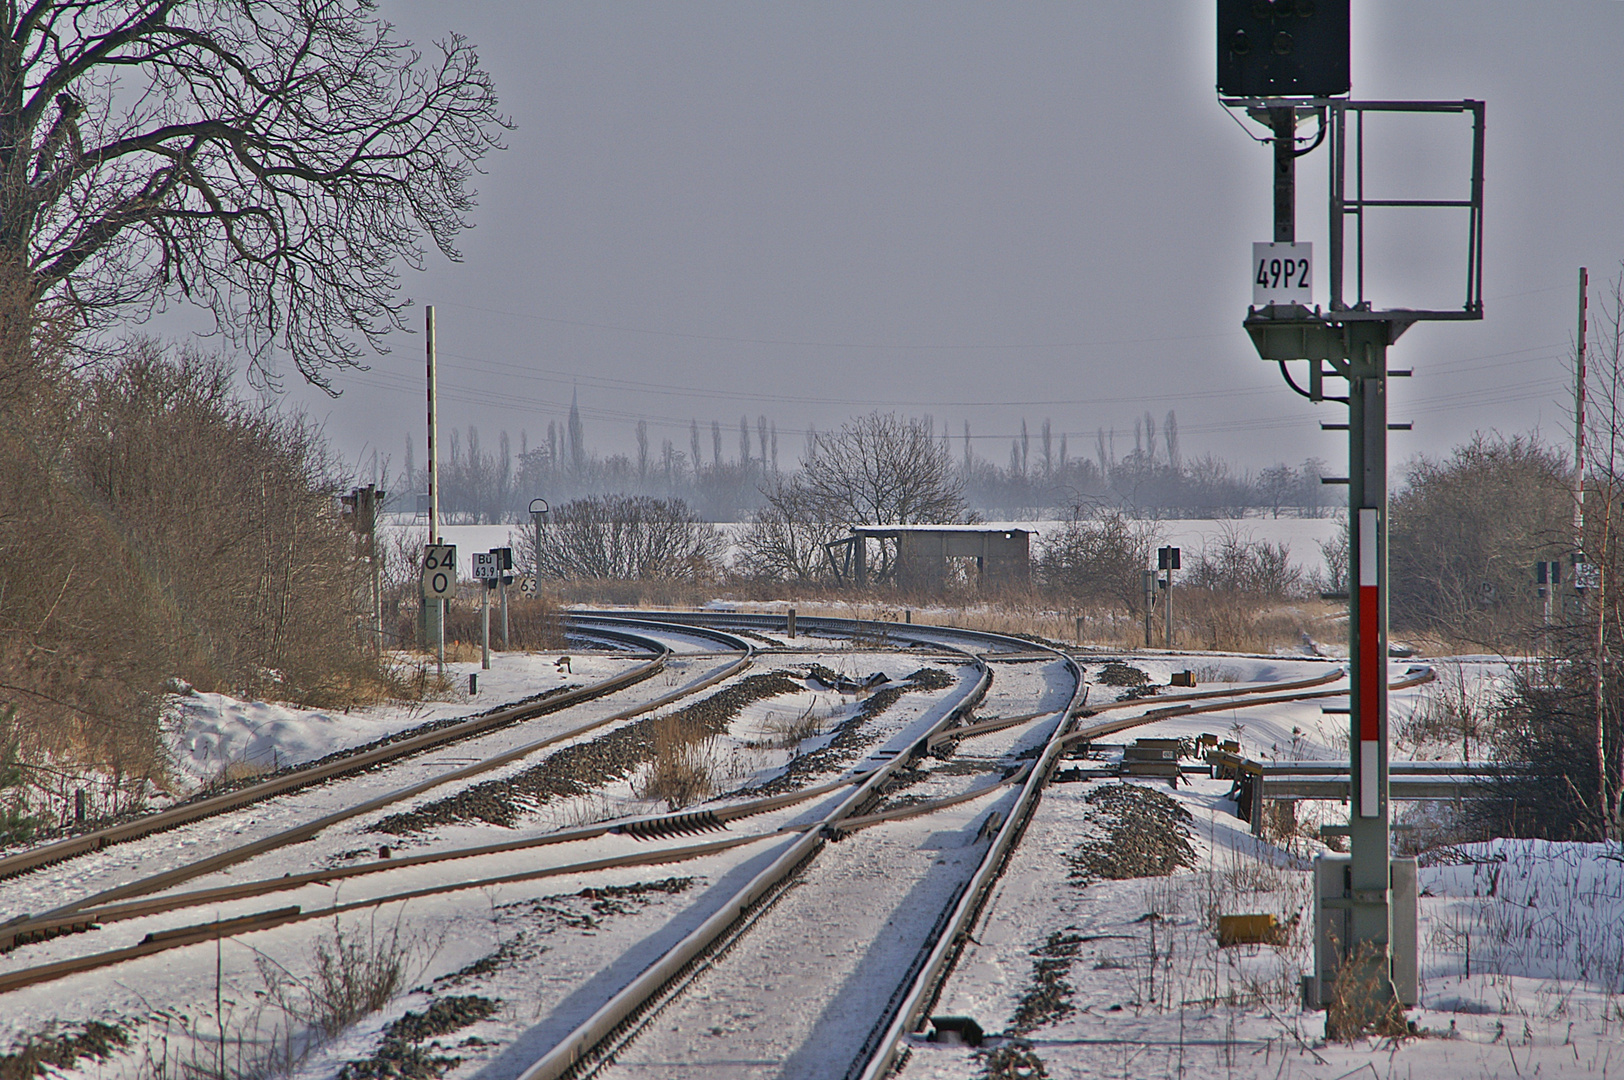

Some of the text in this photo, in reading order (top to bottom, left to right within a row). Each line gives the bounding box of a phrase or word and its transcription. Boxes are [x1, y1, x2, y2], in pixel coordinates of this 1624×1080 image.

[1256, 258, 1309, 288] 49P2
[425, 550, 454, 570] 64
[475, 567, 495, 577] 63.9
[432, 572, 448, 593] 0
[521, 579, 537, 591] 63
